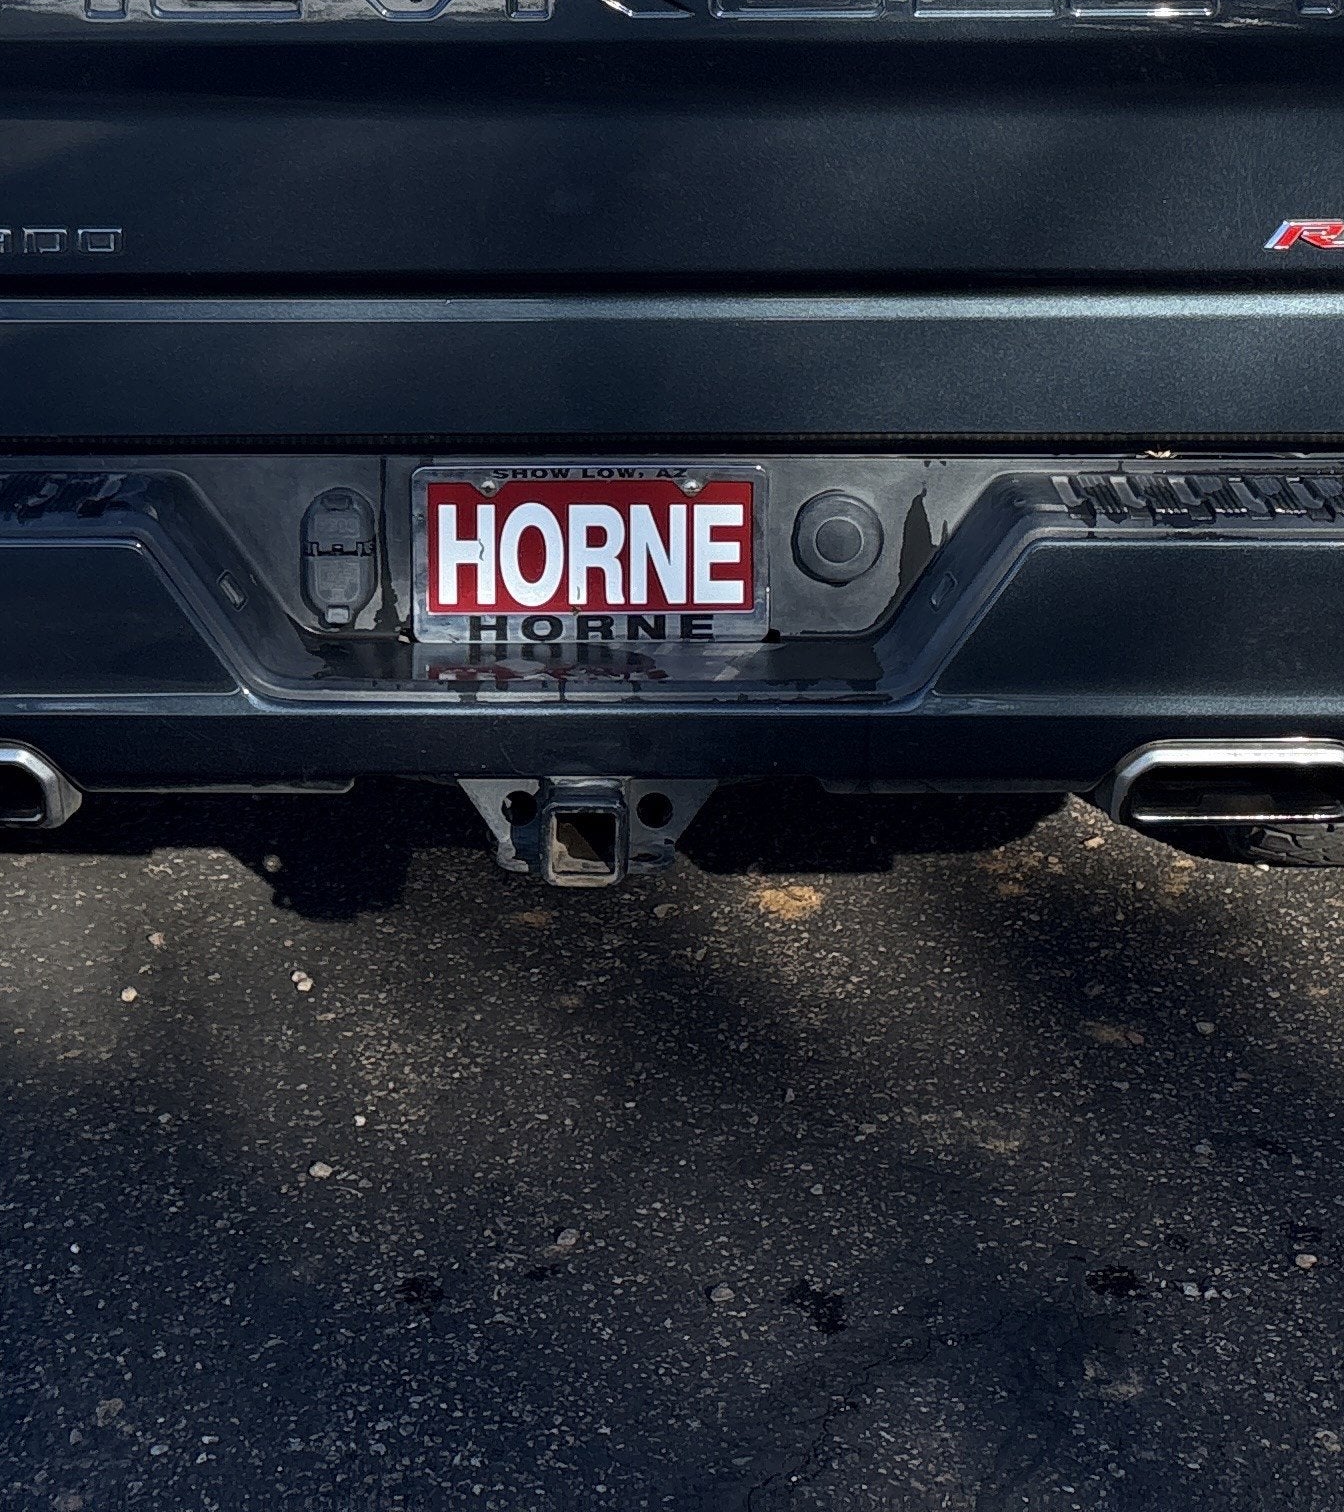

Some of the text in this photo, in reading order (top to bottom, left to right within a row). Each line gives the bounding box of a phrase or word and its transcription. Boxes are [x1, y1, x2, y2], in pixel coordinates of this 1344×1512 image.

[492, 467, 570, 480] SHOW
[655, 467, 689, 479] AZ
[437, 502, 745, 607] HORNE
[468, 614, 716, 641] HORNE
